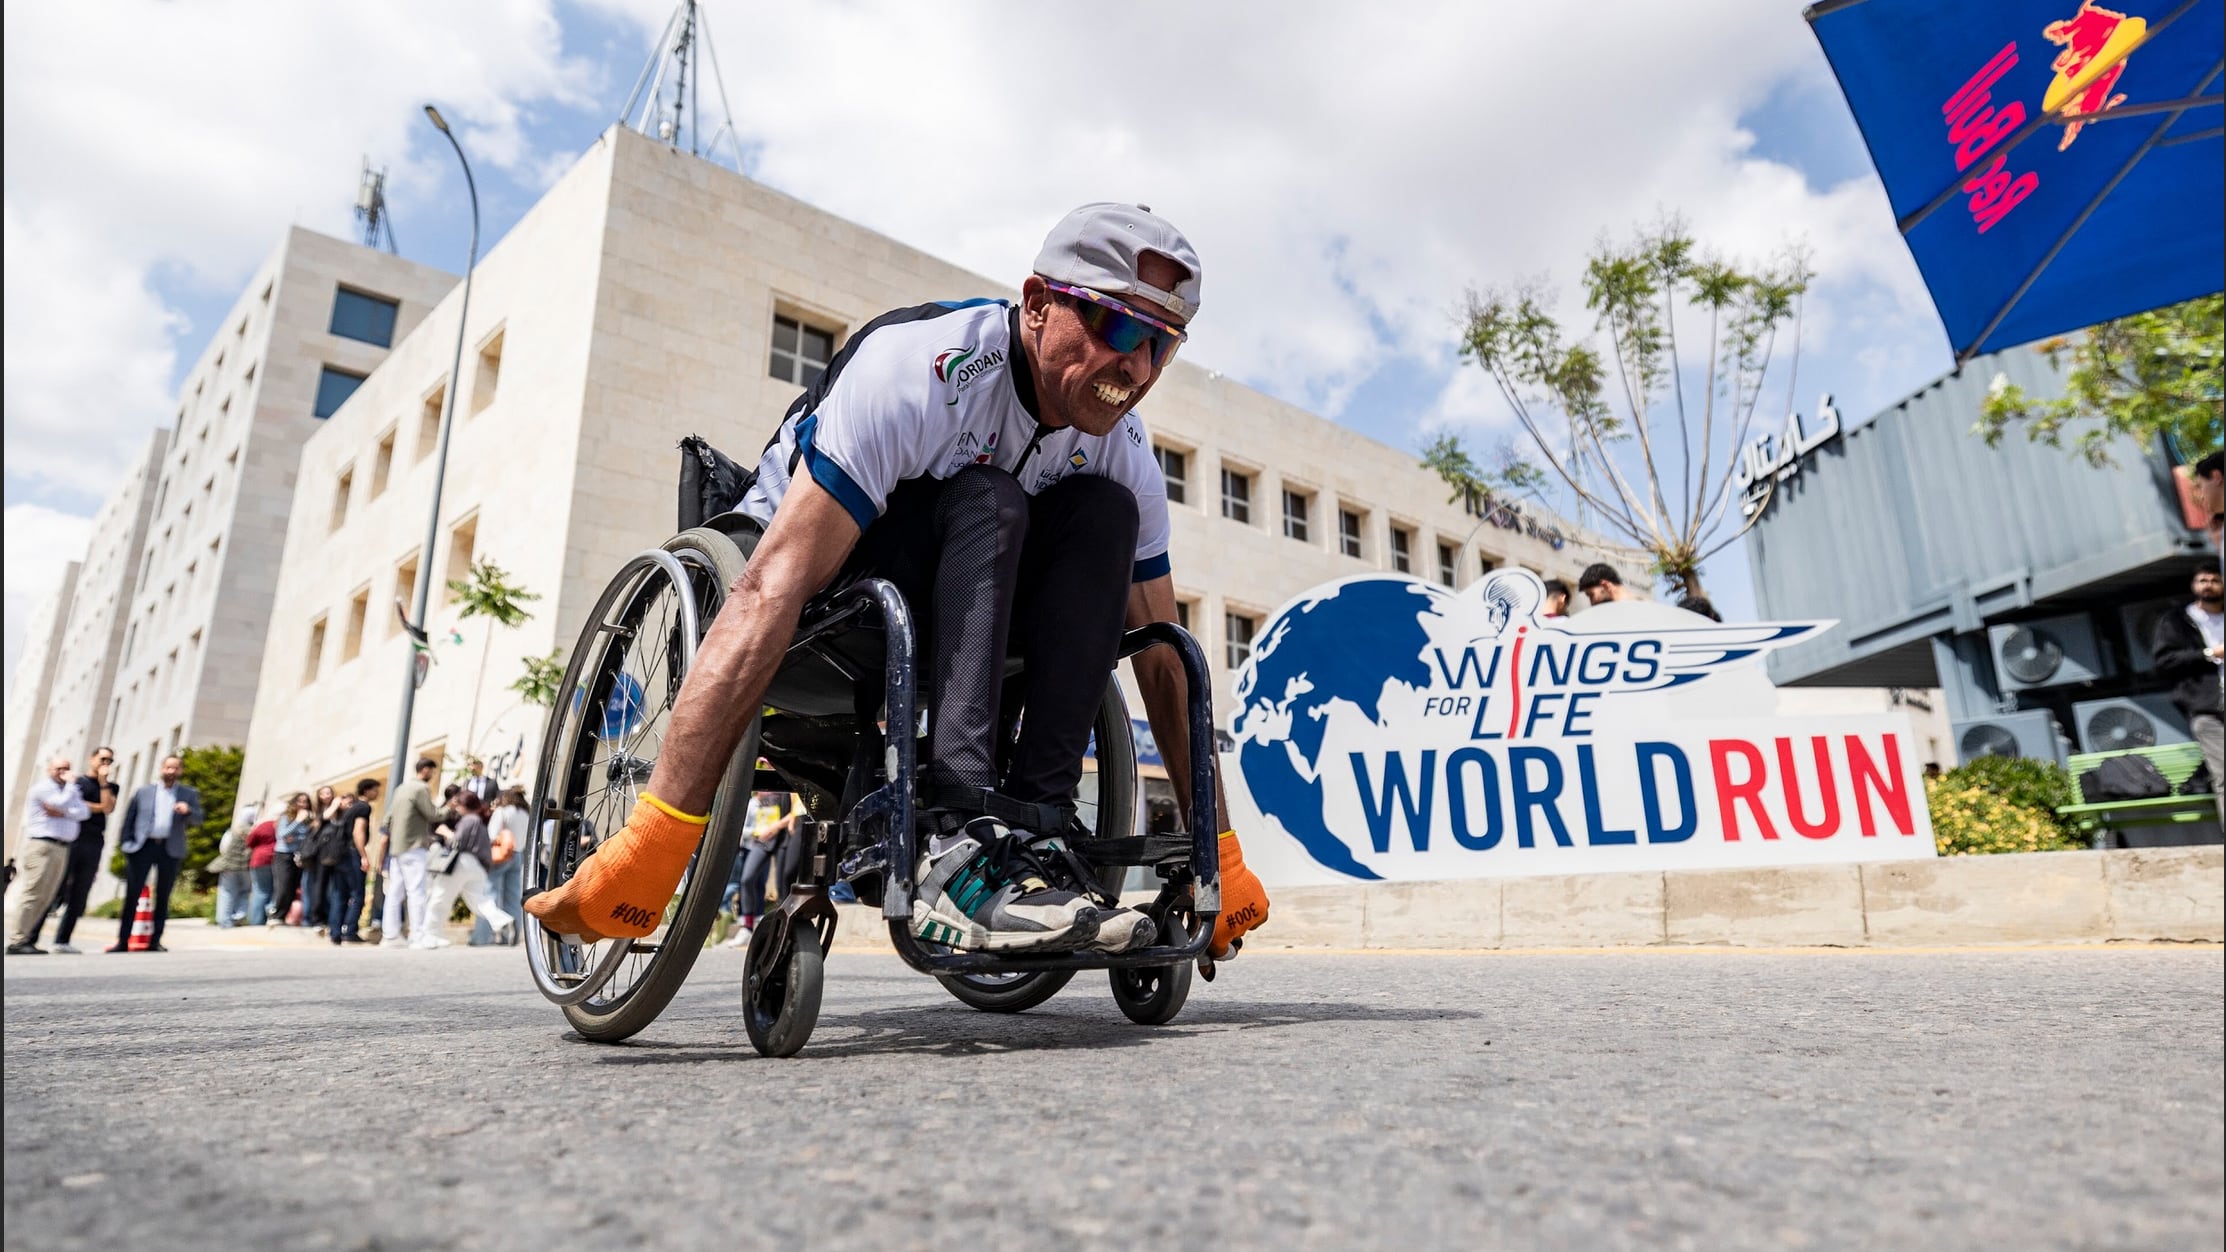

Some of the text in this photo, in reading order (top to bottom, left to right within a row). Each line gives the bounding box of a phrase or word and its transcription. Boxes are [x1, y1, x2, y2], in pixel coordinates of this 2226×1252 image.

[1425, 695, 1471, 717] FOR
[1348, 732, 1917, 854] WORLD RUN
